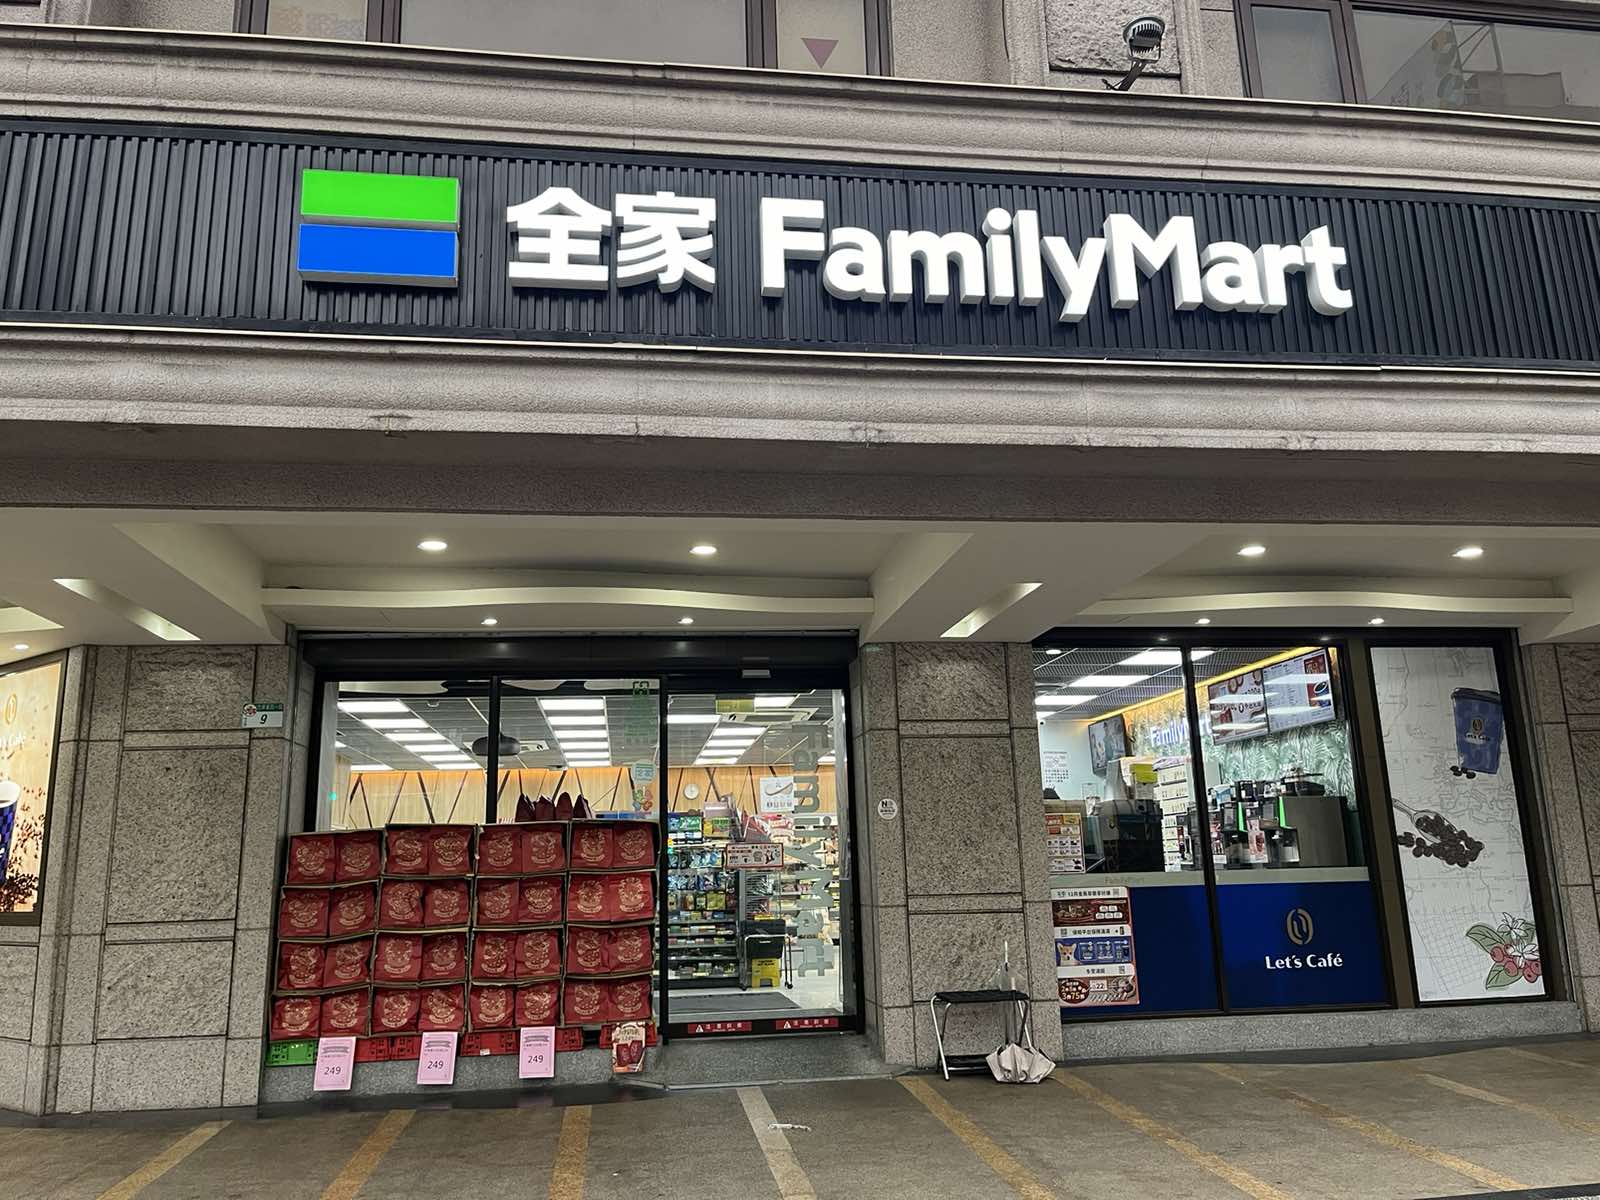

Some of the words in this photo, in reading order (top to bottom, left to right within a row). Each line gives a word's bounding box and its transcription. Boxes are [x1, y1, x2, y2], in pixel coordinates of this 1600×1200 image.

[507, 186, 717, 294] 全家
[760, 197, 1353, 322] FamilyMart
[260, 714, 268, 724] 9
[1265, 954, 1302, 969] Let's
[1306, 953, 1343, 968] Café
[427, 1060, 444, 1069] 249
[528, 1055, 544, 1064] 249
[324, 1066, 341, 1076] 249
